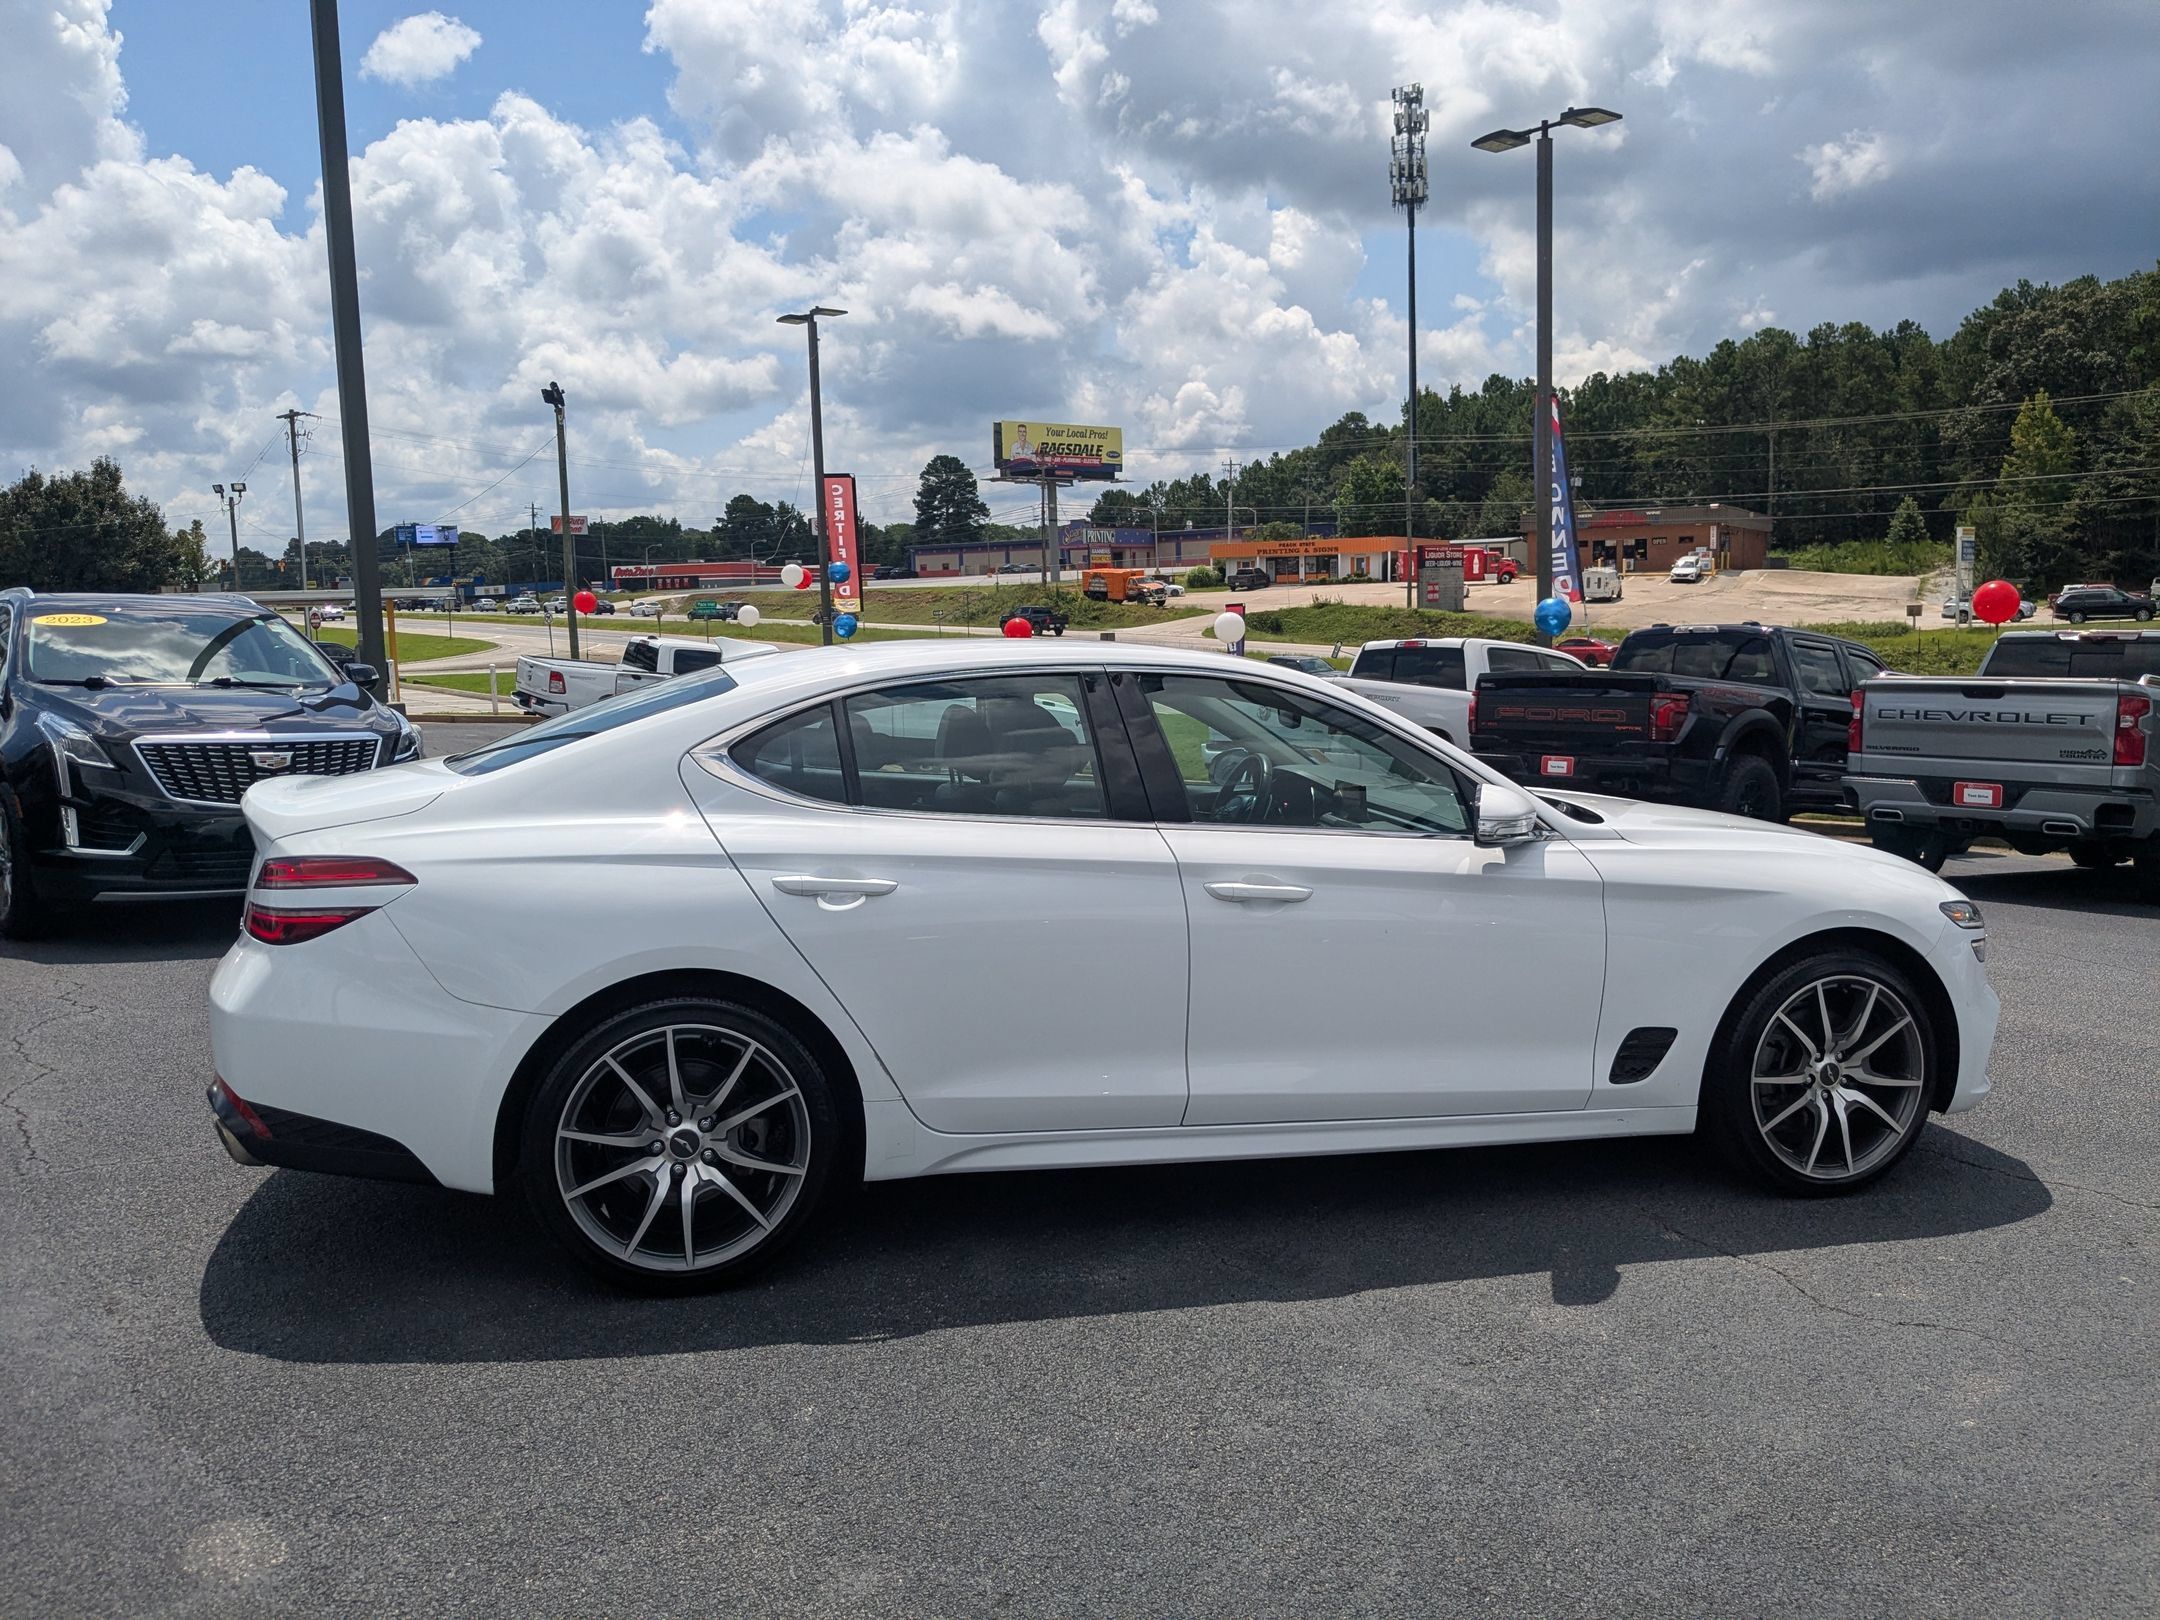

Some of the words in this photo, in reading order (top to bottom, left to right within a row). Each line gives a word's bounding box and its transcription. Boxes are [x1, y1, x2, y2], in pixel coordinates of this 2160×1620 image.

[1046, 427, 1065, 437] Your
[1066, 428, 1087, 438] Local
[1088, 430, 1108, 440] Pros!
[1039, 442, 1104, 457] RAGSDALE
[1087, 530, 1115, 544] PRINTING
[46, 616, 93, 624] 2023
[1495, 706, 1627, 722] FORD
[1878, 708, 2095, 726] CHEVROLET
